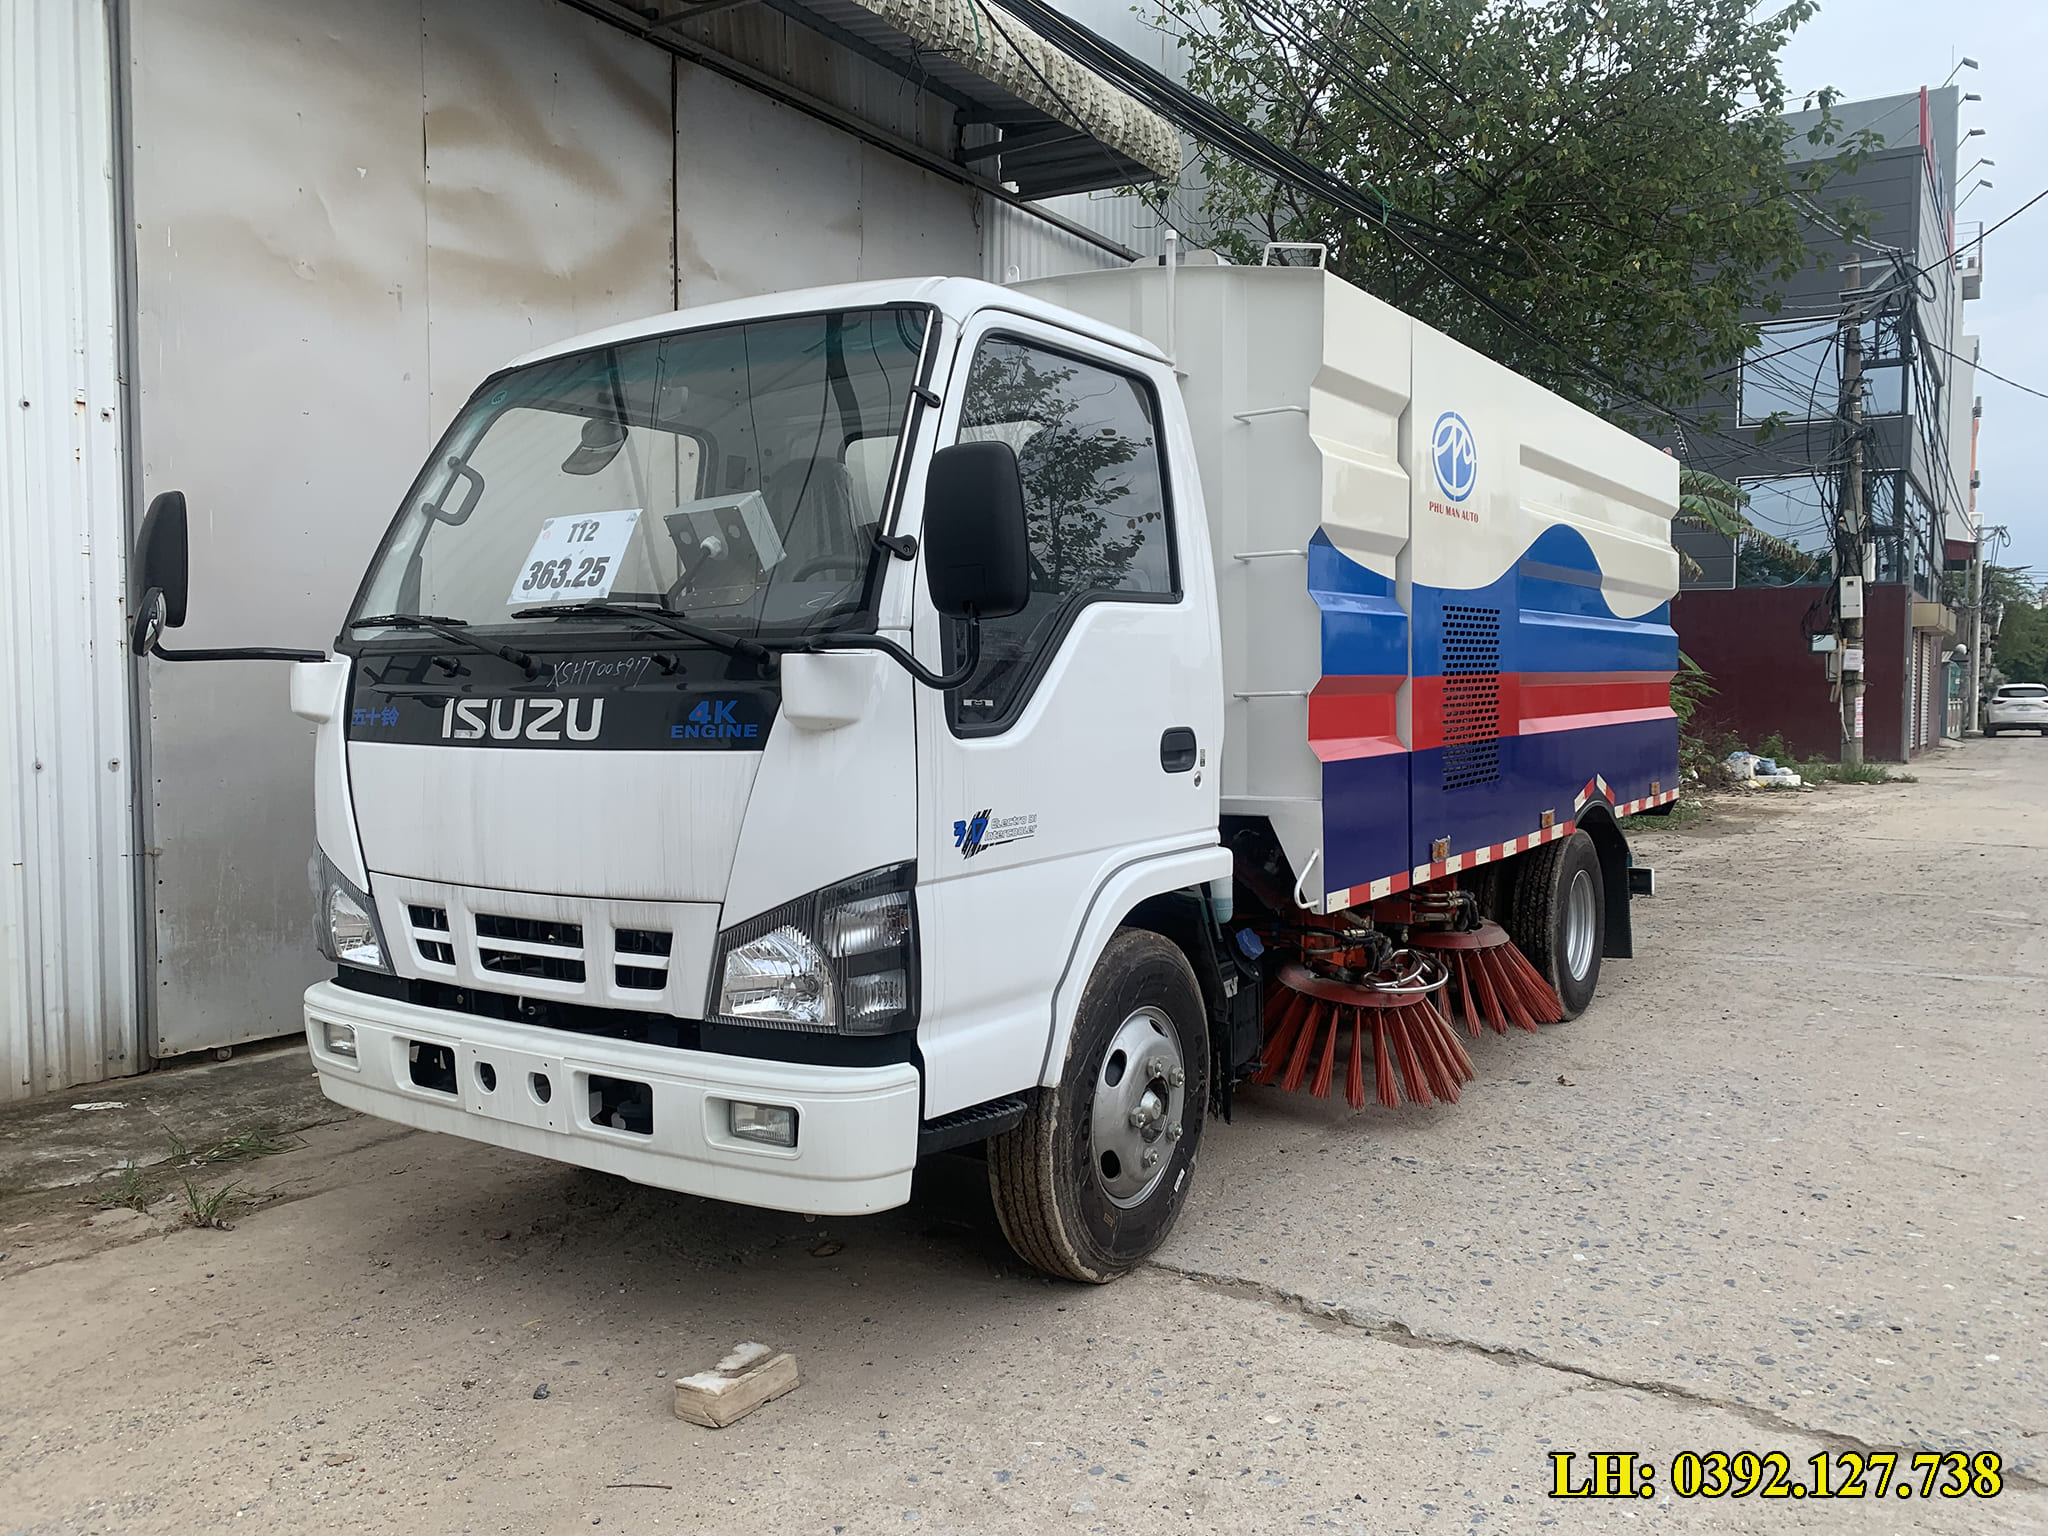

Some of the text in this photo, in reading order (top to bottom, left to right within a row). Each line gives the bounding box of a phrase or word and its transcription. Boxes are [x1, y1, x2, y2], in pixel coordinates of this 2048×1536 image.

[1429, 500, 1479, 523] PHU MAN AUTO
[567, 521, 600, 543] T12
[522, 556, 611, 591] 363.25
[441, 698, 604, 741] ISUZU
[688, 700, 738, 724] 4K
[670, 723, 758, 739] ENGINE
